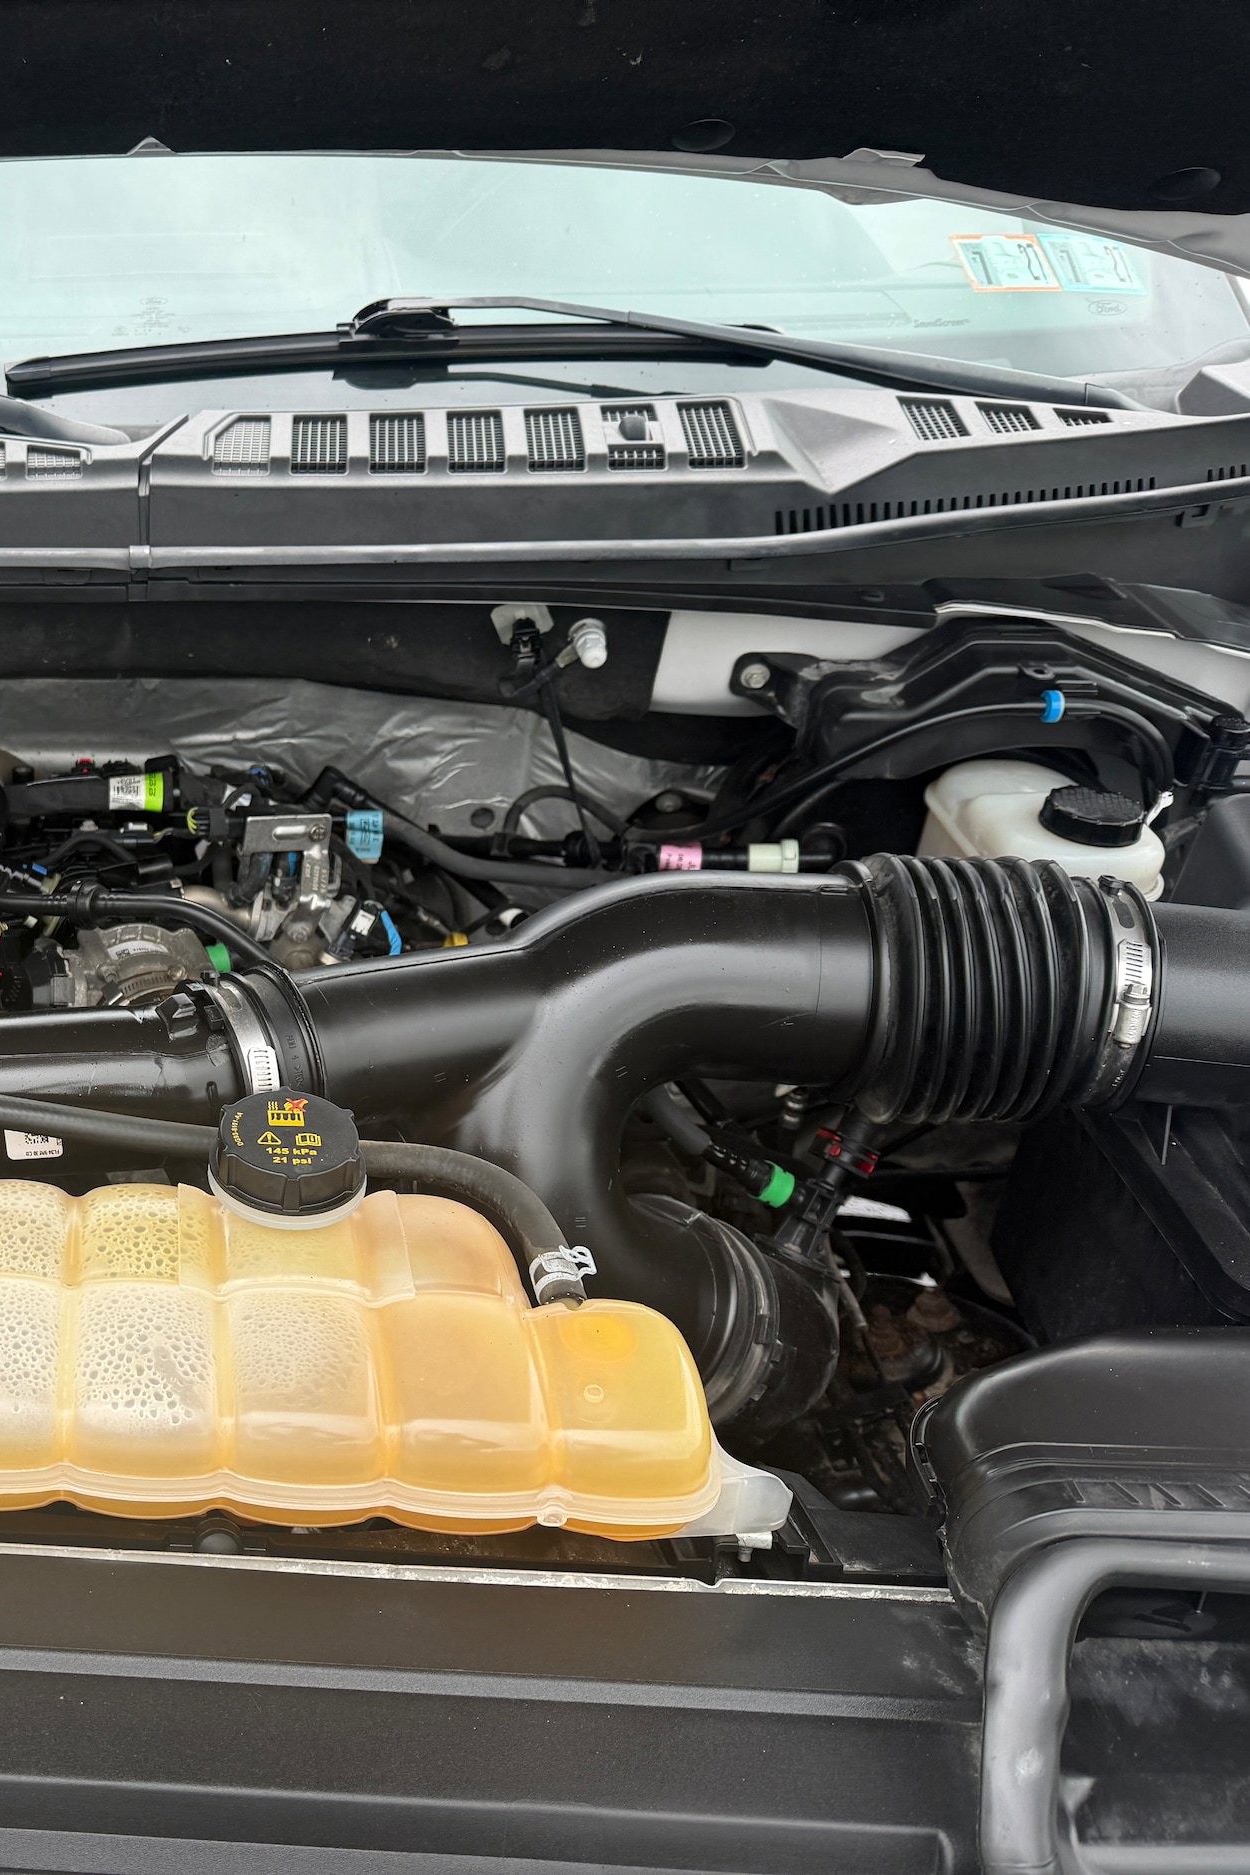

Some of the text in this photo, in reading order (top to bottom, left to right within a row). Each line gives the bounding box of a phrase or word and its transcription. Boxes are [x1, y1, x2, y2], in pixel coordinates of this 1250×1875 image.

[266, 1147, 317, 1156] 145 kPa
[273, 1156, 312, 1165] 21 psi
